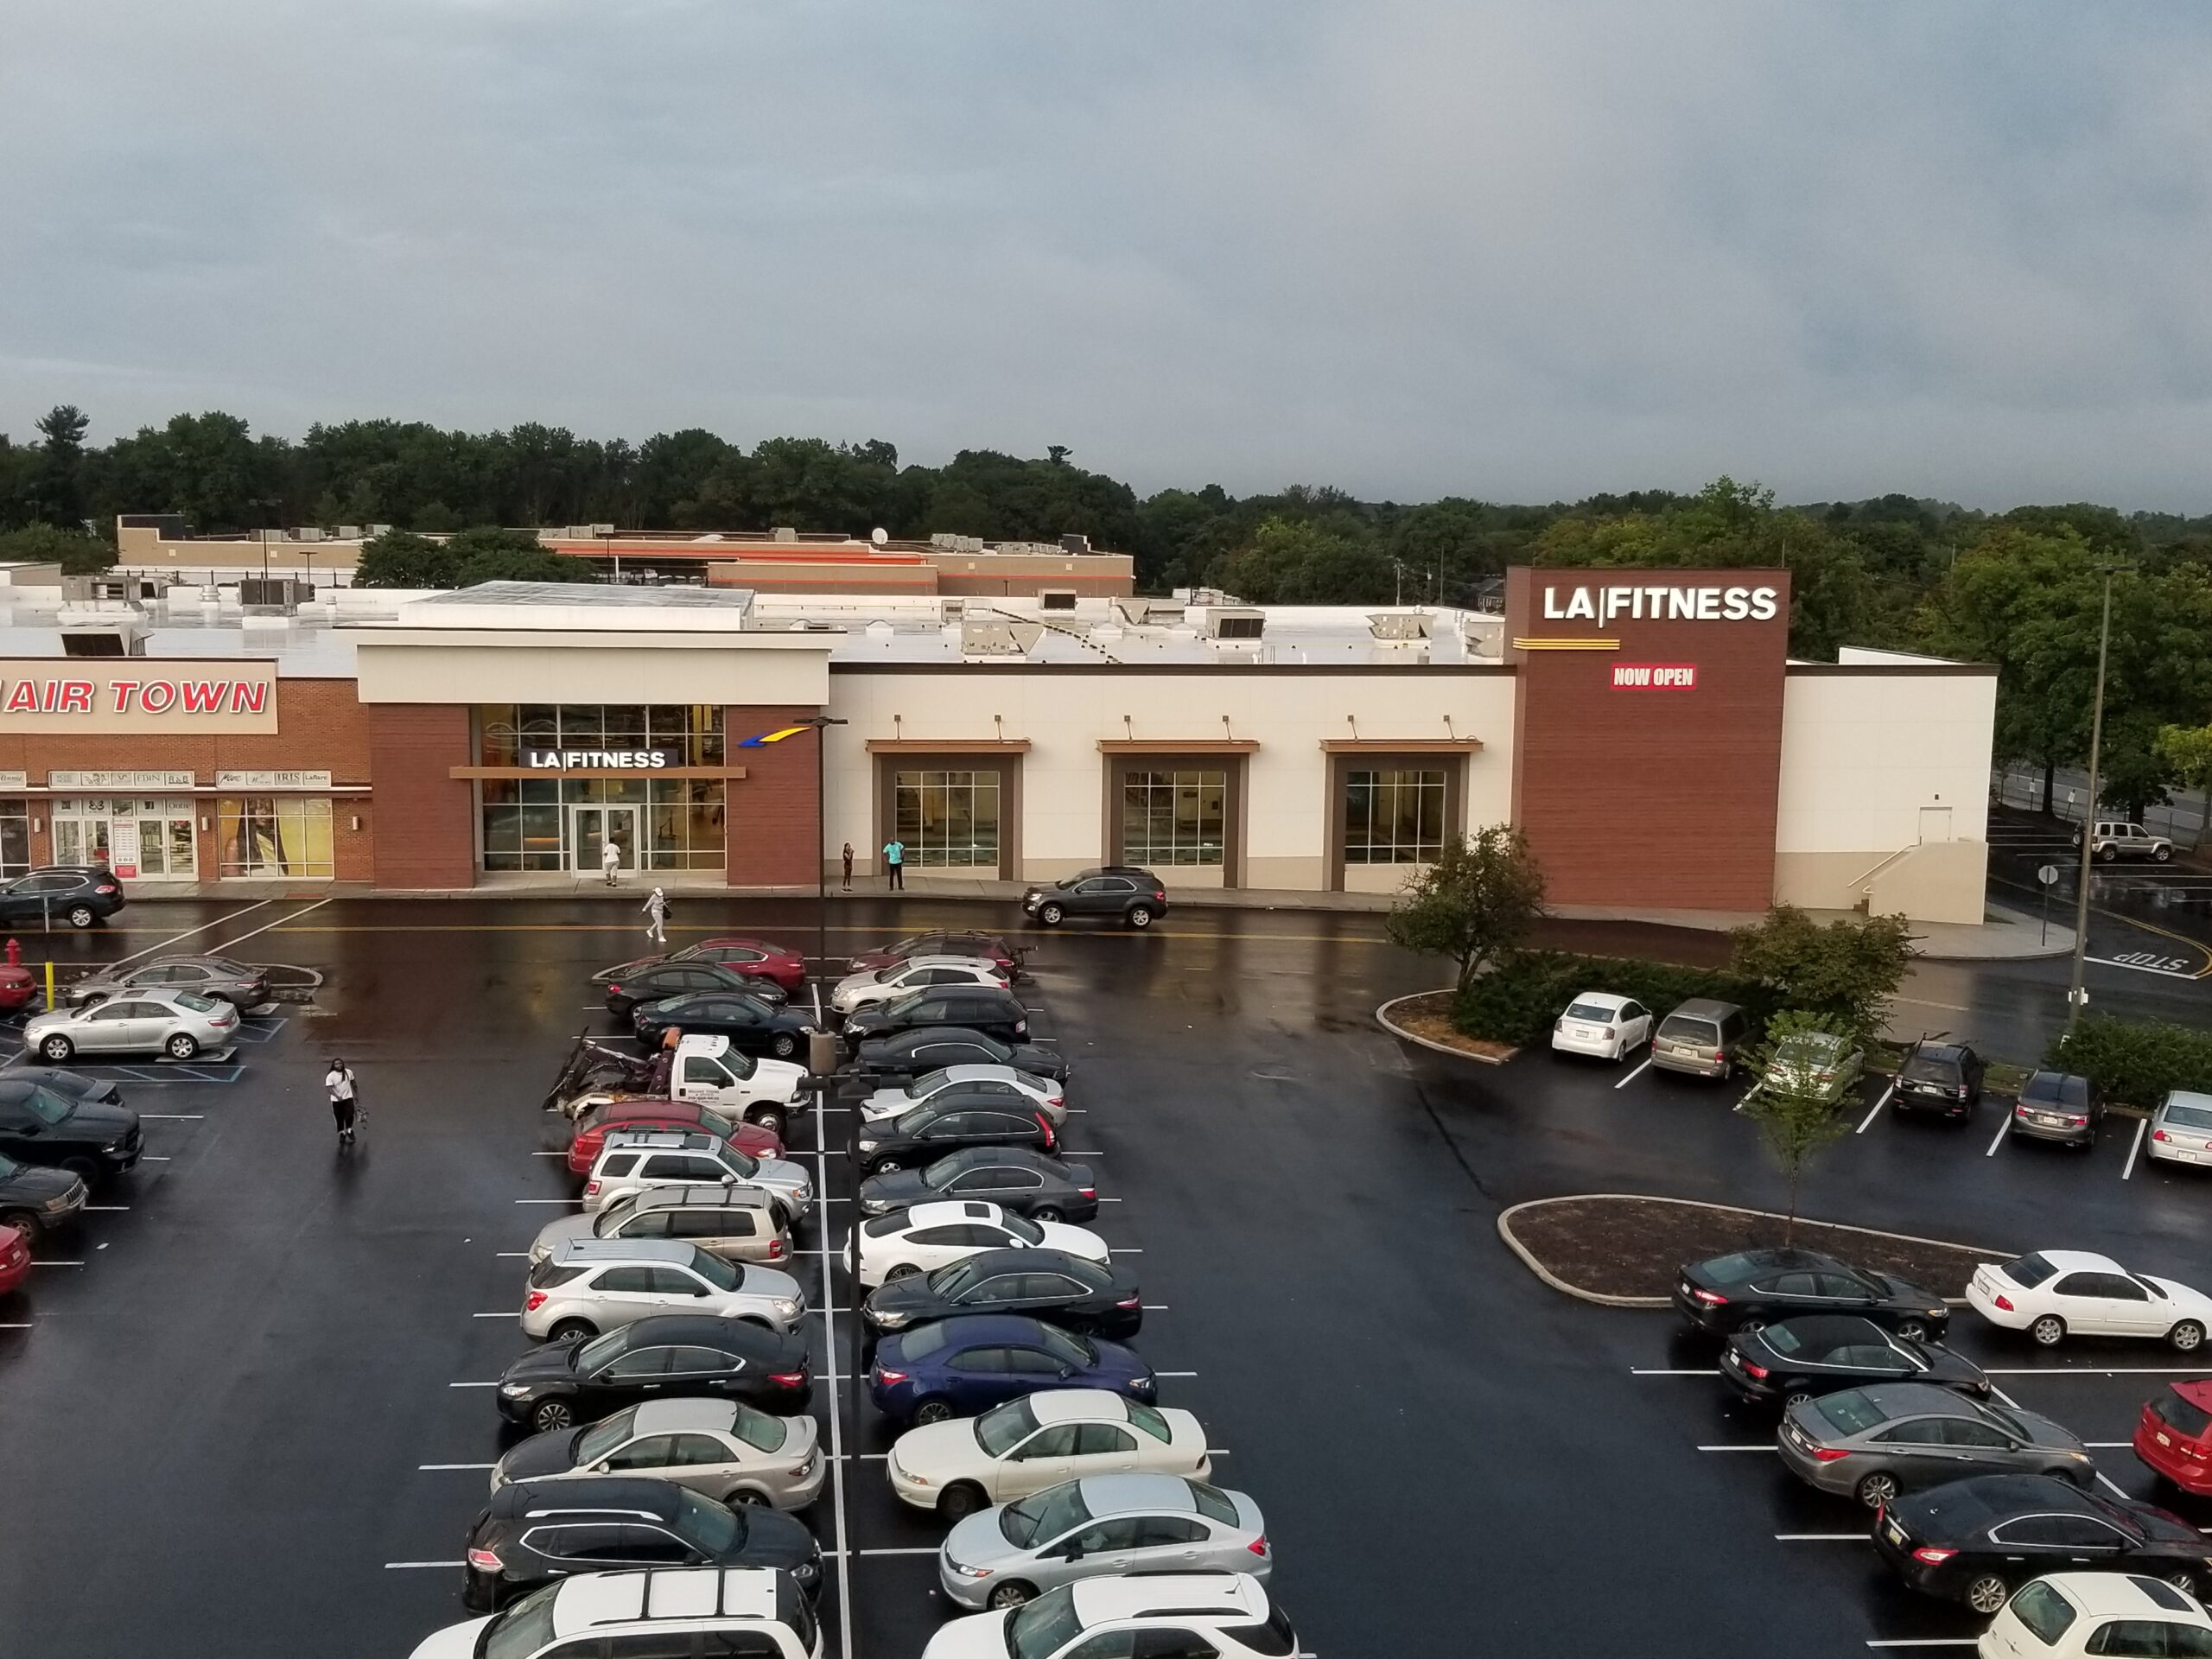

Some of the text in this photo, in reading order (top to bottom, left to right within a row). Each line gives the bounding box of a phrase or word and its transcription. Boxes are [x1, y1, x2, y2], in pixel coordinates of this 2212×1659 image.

[1544, 587, 1778, 620] LA FITNESS
[1613, 668, 1694, 686] NOW OPEN
[0, 679, 268, 714] AIR TOWN
[531, 752, 665, 768] LA FITNESS
[277, 773, 300, 782] IRIS
[2113, 951, 2190, 970] STOP
